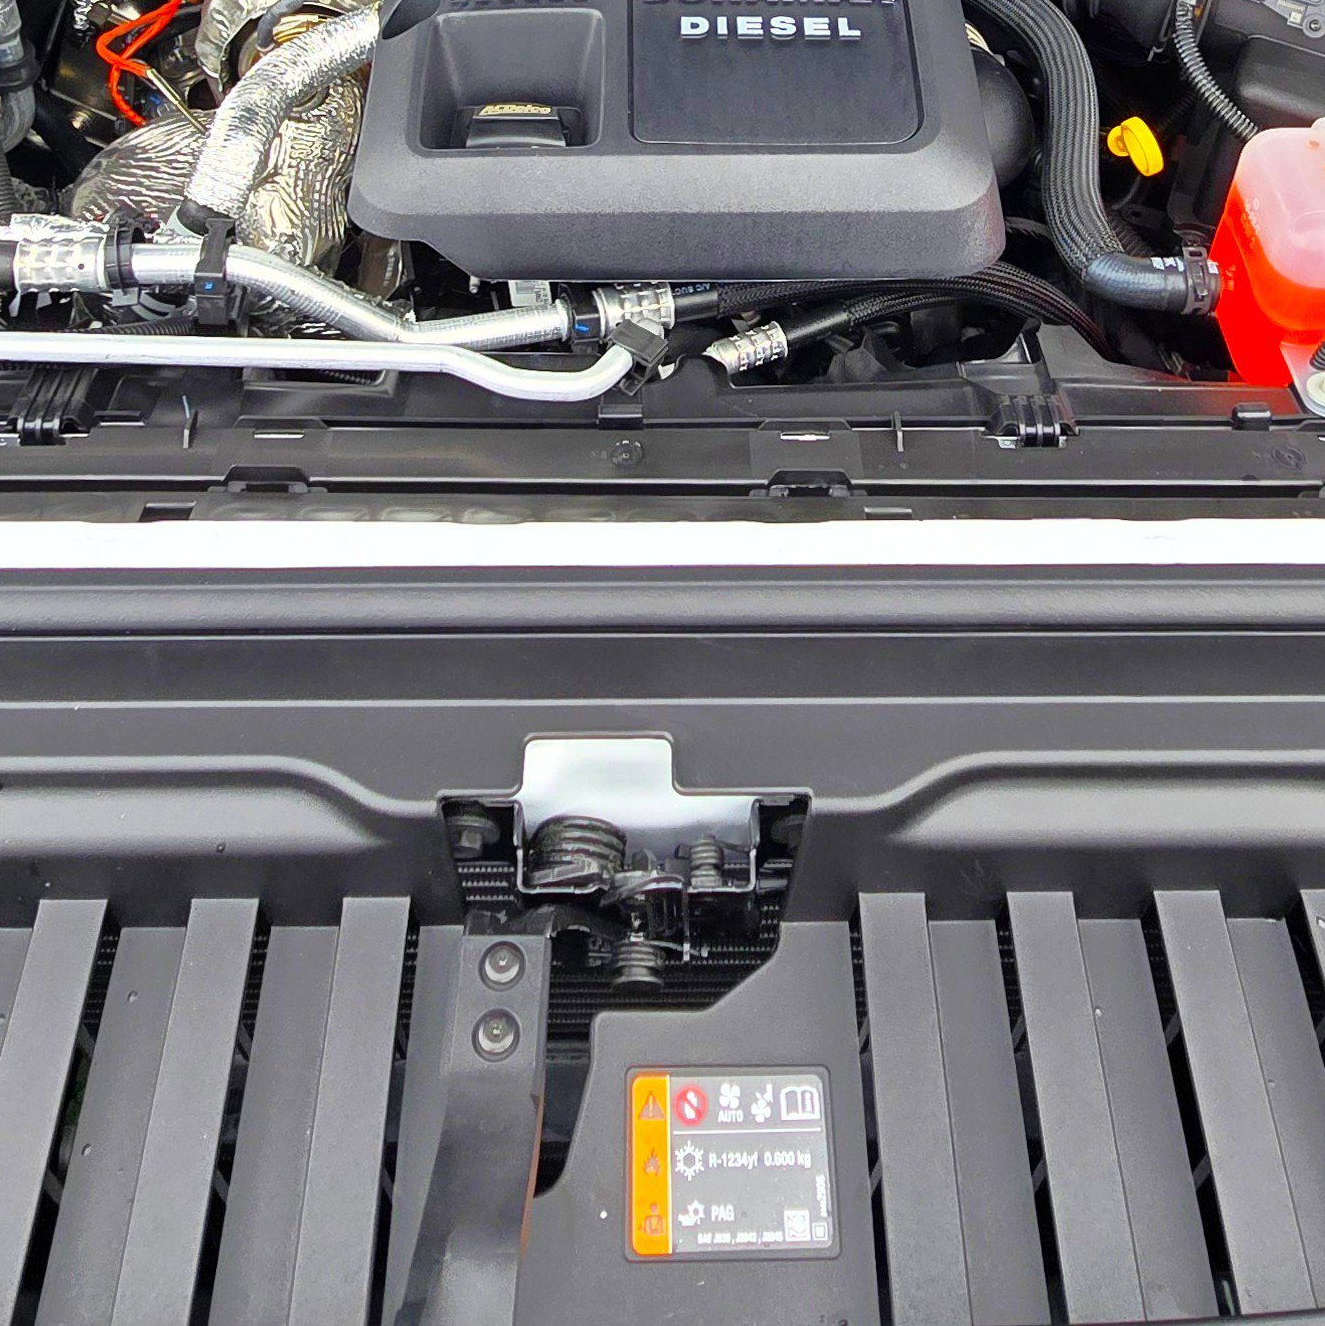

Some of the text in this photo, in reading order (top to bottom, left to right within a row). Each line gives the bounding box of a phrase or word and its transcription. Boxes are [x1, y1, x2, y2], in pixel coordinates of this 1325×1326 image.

[680, 15, 862, 39] DIESEL
[717, 1109, 744, 1123] AUTO
[797, 1149, 812, 1169] kg
[711, 1204, 735, 1222] PAG
